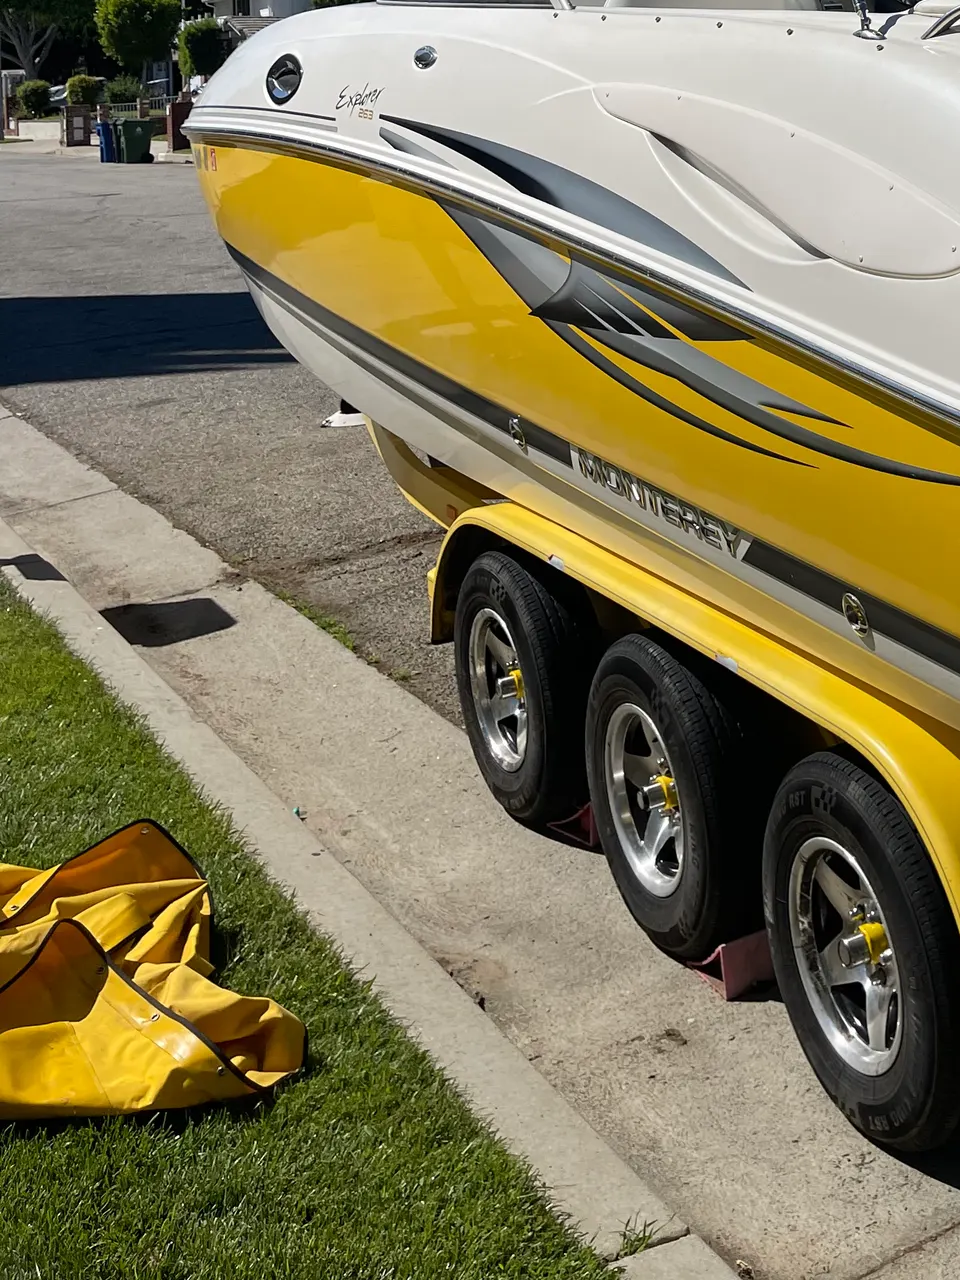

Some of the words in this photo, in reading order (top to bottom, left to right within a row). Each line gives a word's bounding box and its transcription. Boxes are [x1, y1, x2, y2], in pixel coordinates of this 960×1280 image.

[336, 82, 386, 117] Explorer
[358, 107, 374, 120] 263
[577, 447, 742, 559] MONTEREY
